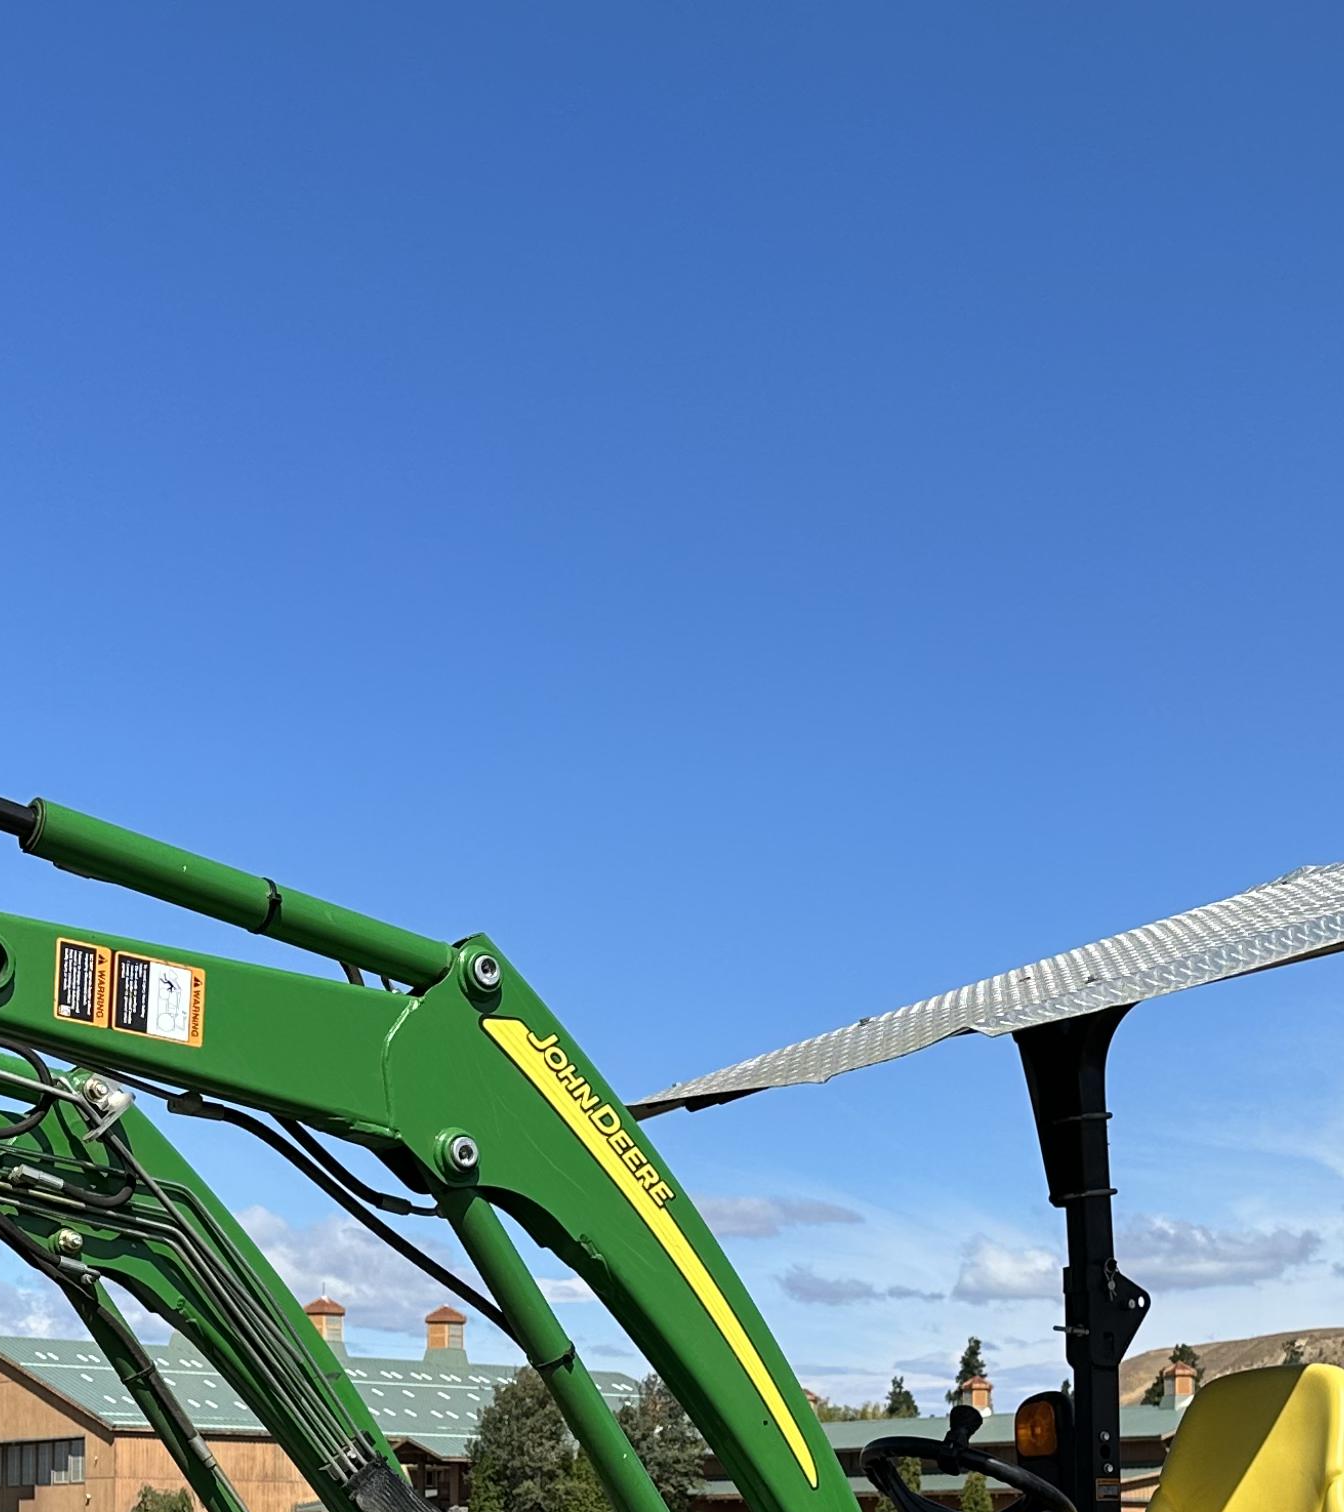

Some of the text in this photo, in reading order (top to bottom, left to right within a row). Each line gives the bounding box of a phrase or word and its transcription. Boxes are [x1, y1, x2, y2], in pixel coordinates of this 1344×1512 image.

[96, 969, 107, 1019] WARNING
[190, 989, 202, 1038] WARNING
[527, 1031, 676, 1208] JOHN DEERE
